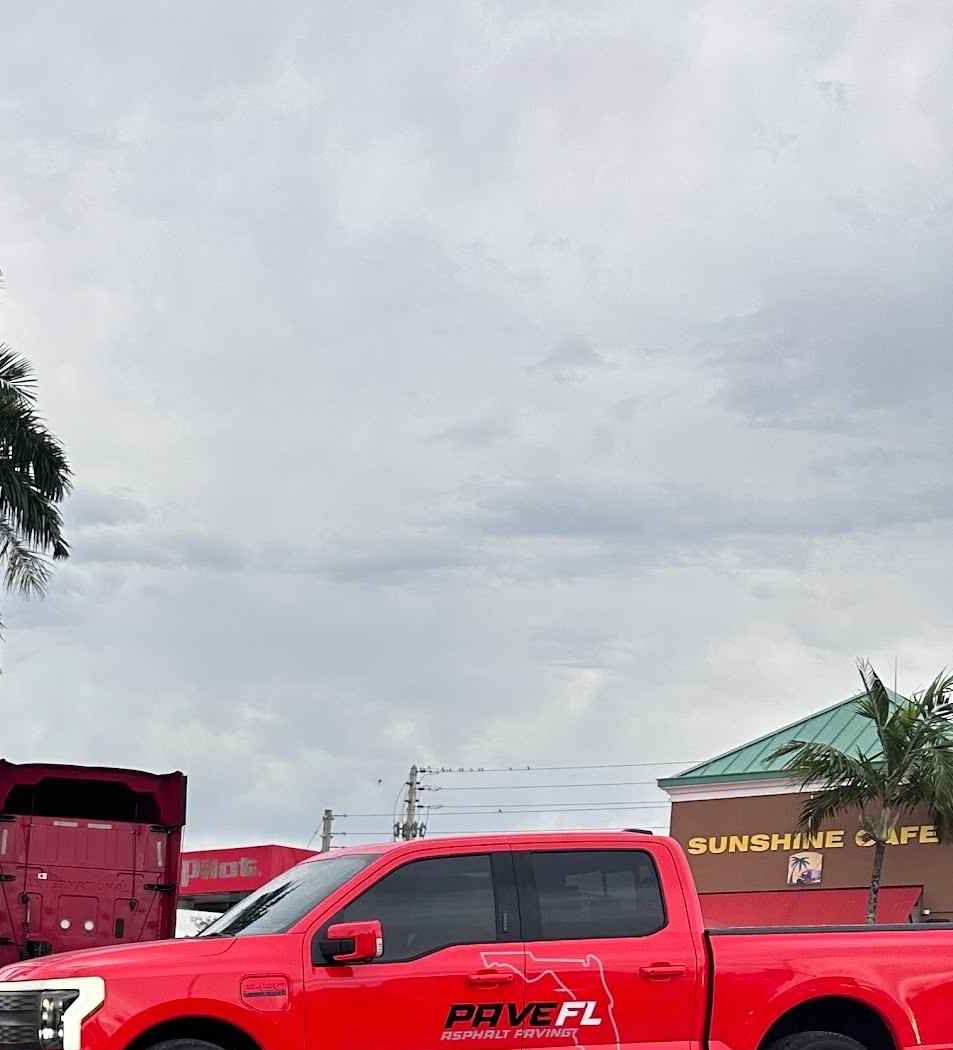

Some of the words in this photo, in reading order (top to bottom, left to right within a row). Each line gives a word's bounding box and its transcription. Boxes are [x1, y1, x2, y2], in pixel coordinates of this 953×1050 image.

[687, 830, 845, 855] SUNSHINE
[440, 1029, 511, 1041] ASPHALT
[514, 1028, 574, 1039] PAVING
